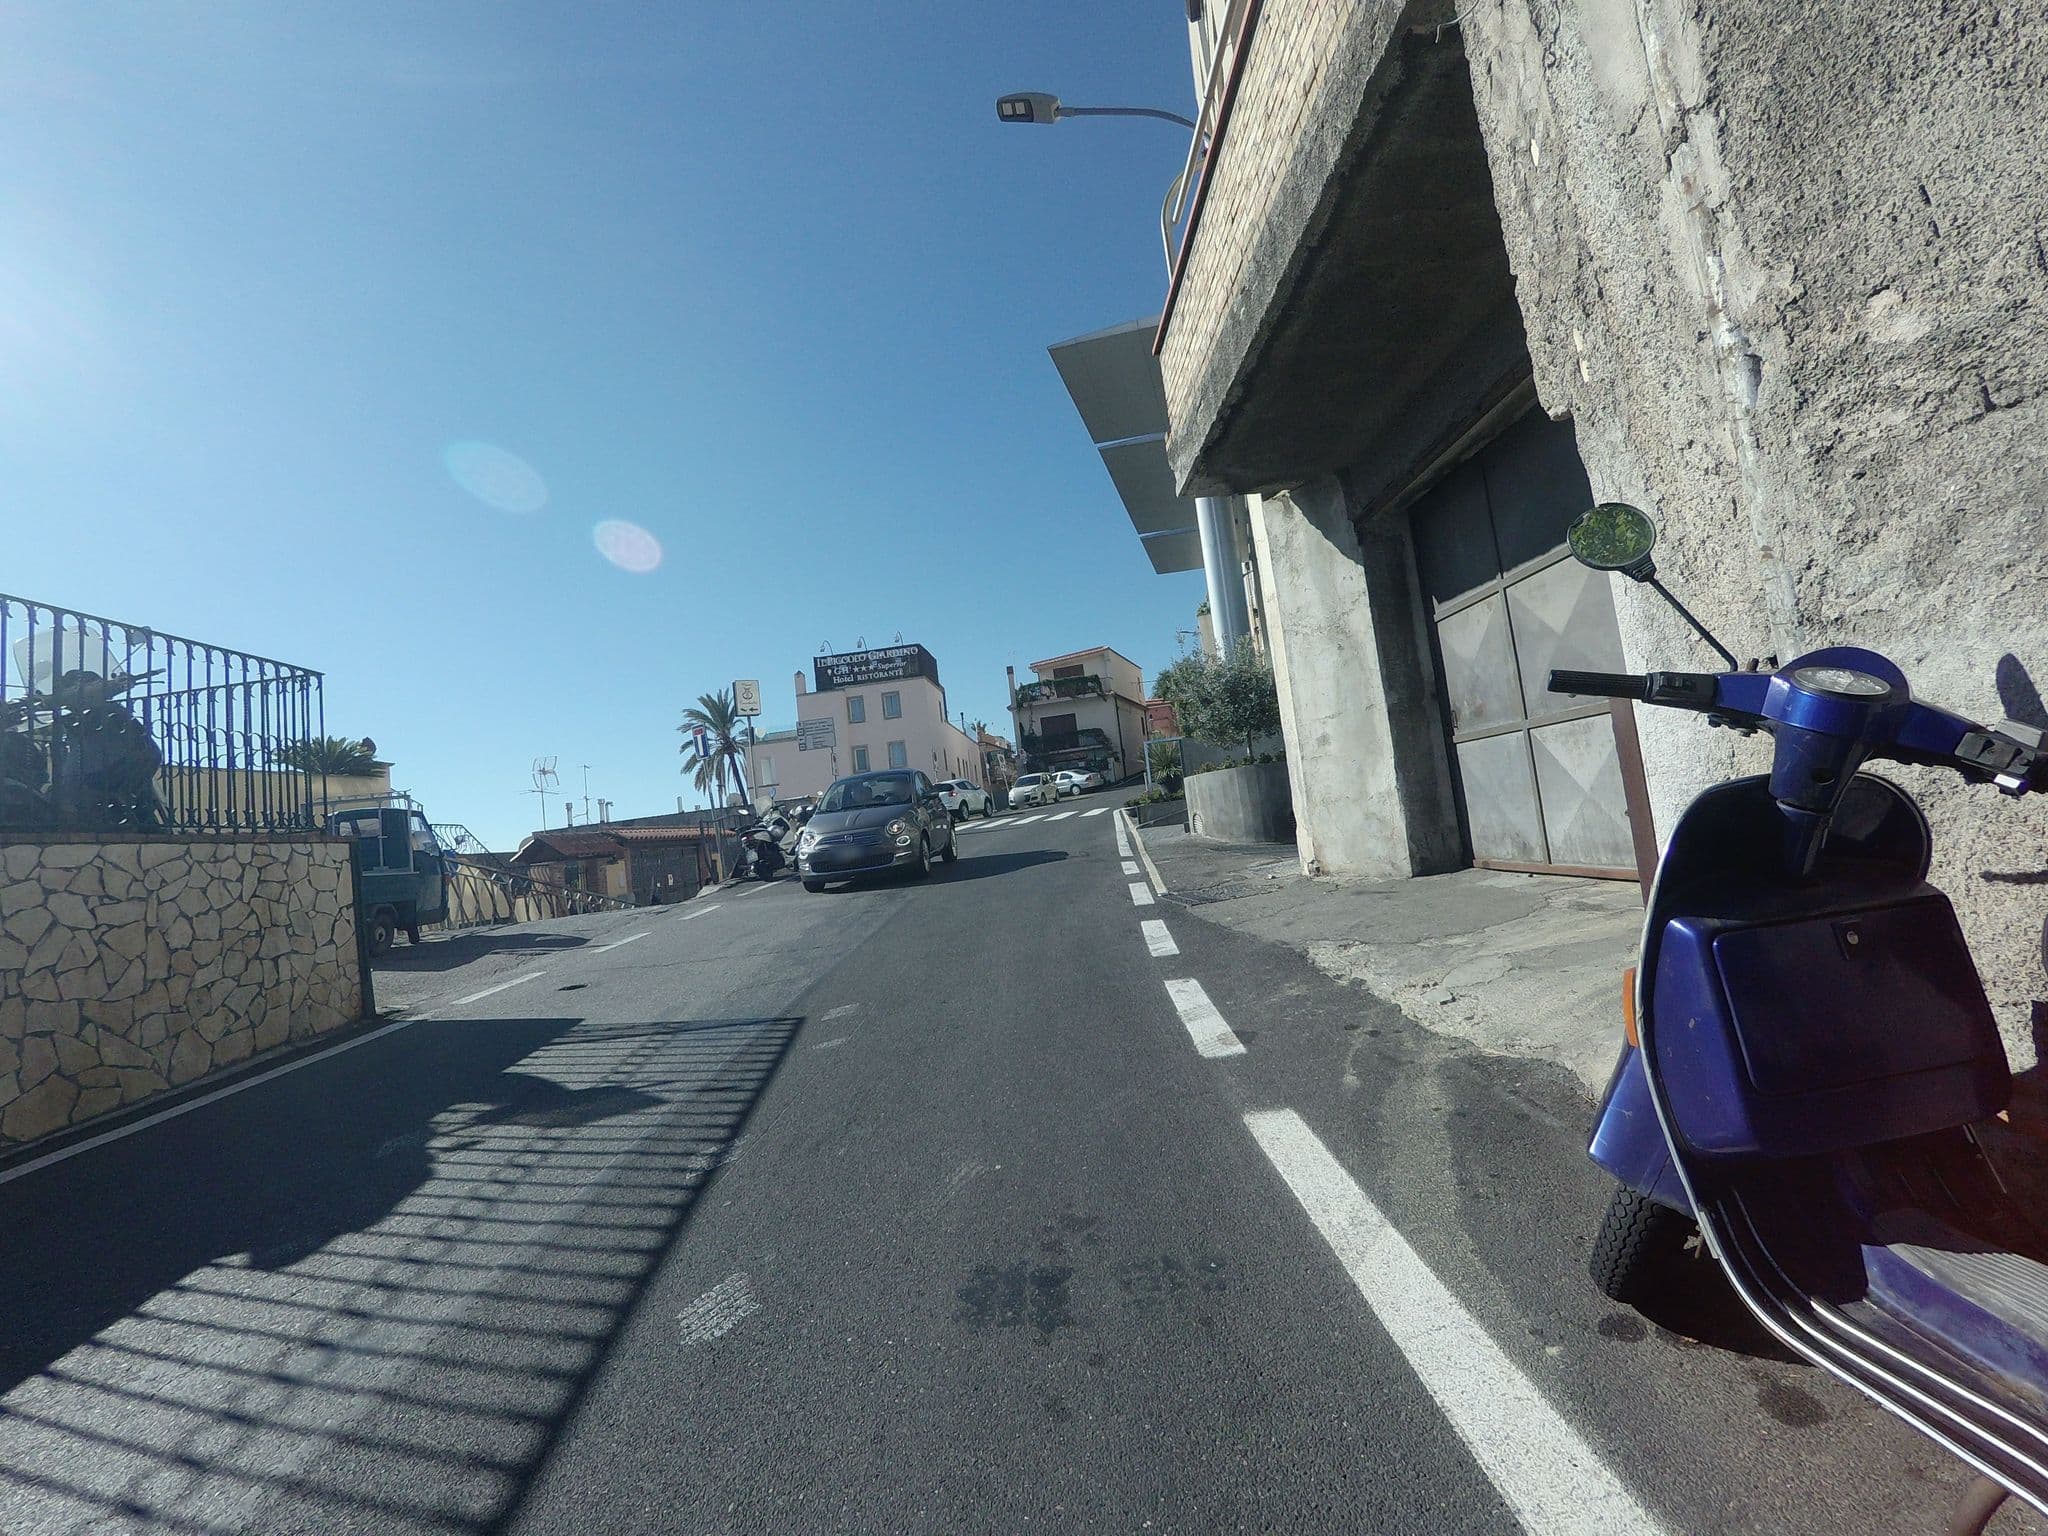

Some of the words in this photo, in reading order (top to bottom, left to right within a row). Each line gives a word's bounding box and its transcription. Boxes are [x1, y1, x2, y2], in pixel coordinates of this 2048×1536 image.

[868, 646, 918, 660] GIARDINO
[833, 674, 854, 684] Hotel
[857, 668, 904, 680] RISTORANTE
